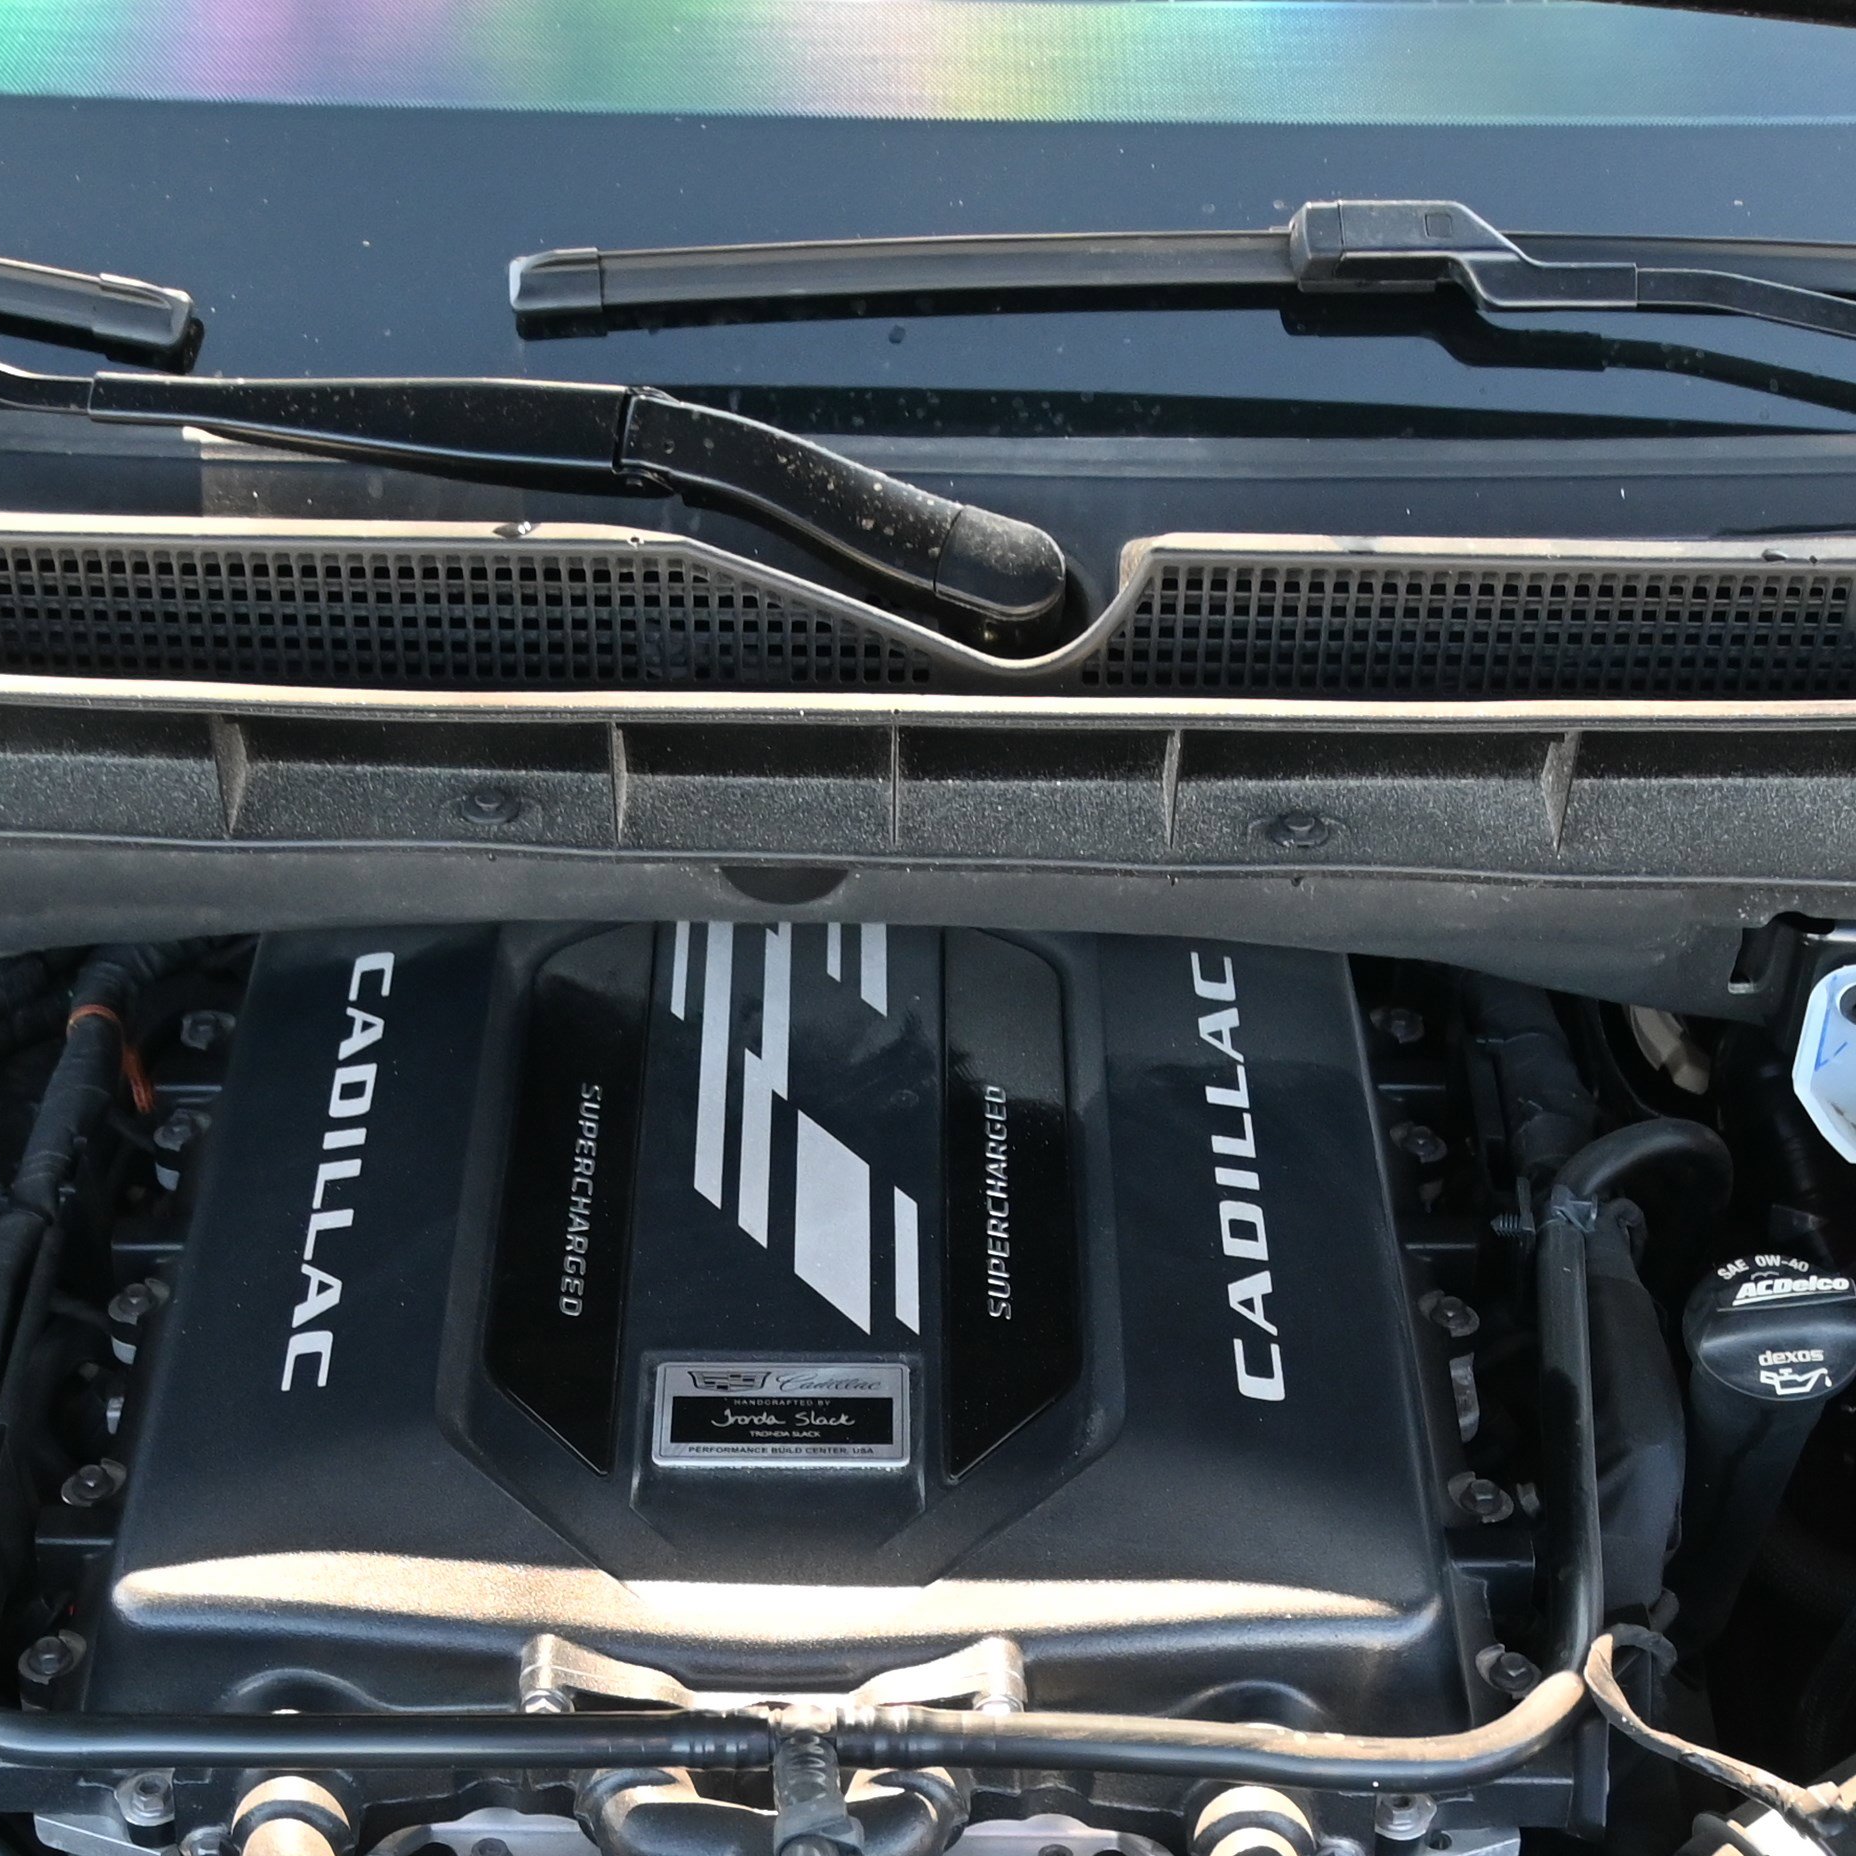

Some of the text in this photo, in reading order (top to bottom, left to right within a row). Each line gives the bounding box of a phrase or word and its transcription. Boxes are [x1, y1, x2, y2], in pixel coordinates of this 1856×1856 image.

[281, 951, 395, 1392] CADILLAC
[1189, 951, 1286, 1401] CADILLAC
[559, 1082, 603, 1318] SUPERCHARGED
[986, 1084, 1012, 1321] SUPERCHARGED
[1717, 1254, 1810, 1281] SAE 0W-40
[1735, 1275, 1850, 1301] ACDelco
[1758, 1349, 1824, 1367] dexos
[774, 1372, 882, 1393] Cadillac
[734, 1399, 832, 1407] HANDCRAFTED BY
[795, 1409, 856, 1427] Slack
[749, 1430, 822, 1438] TRONDA SLACK
[688, 1446, 768, 1455] PERFORMANCE
[771, 1446, 803, 1455] BUILD
[852, 1447, 875, 1455] USA
